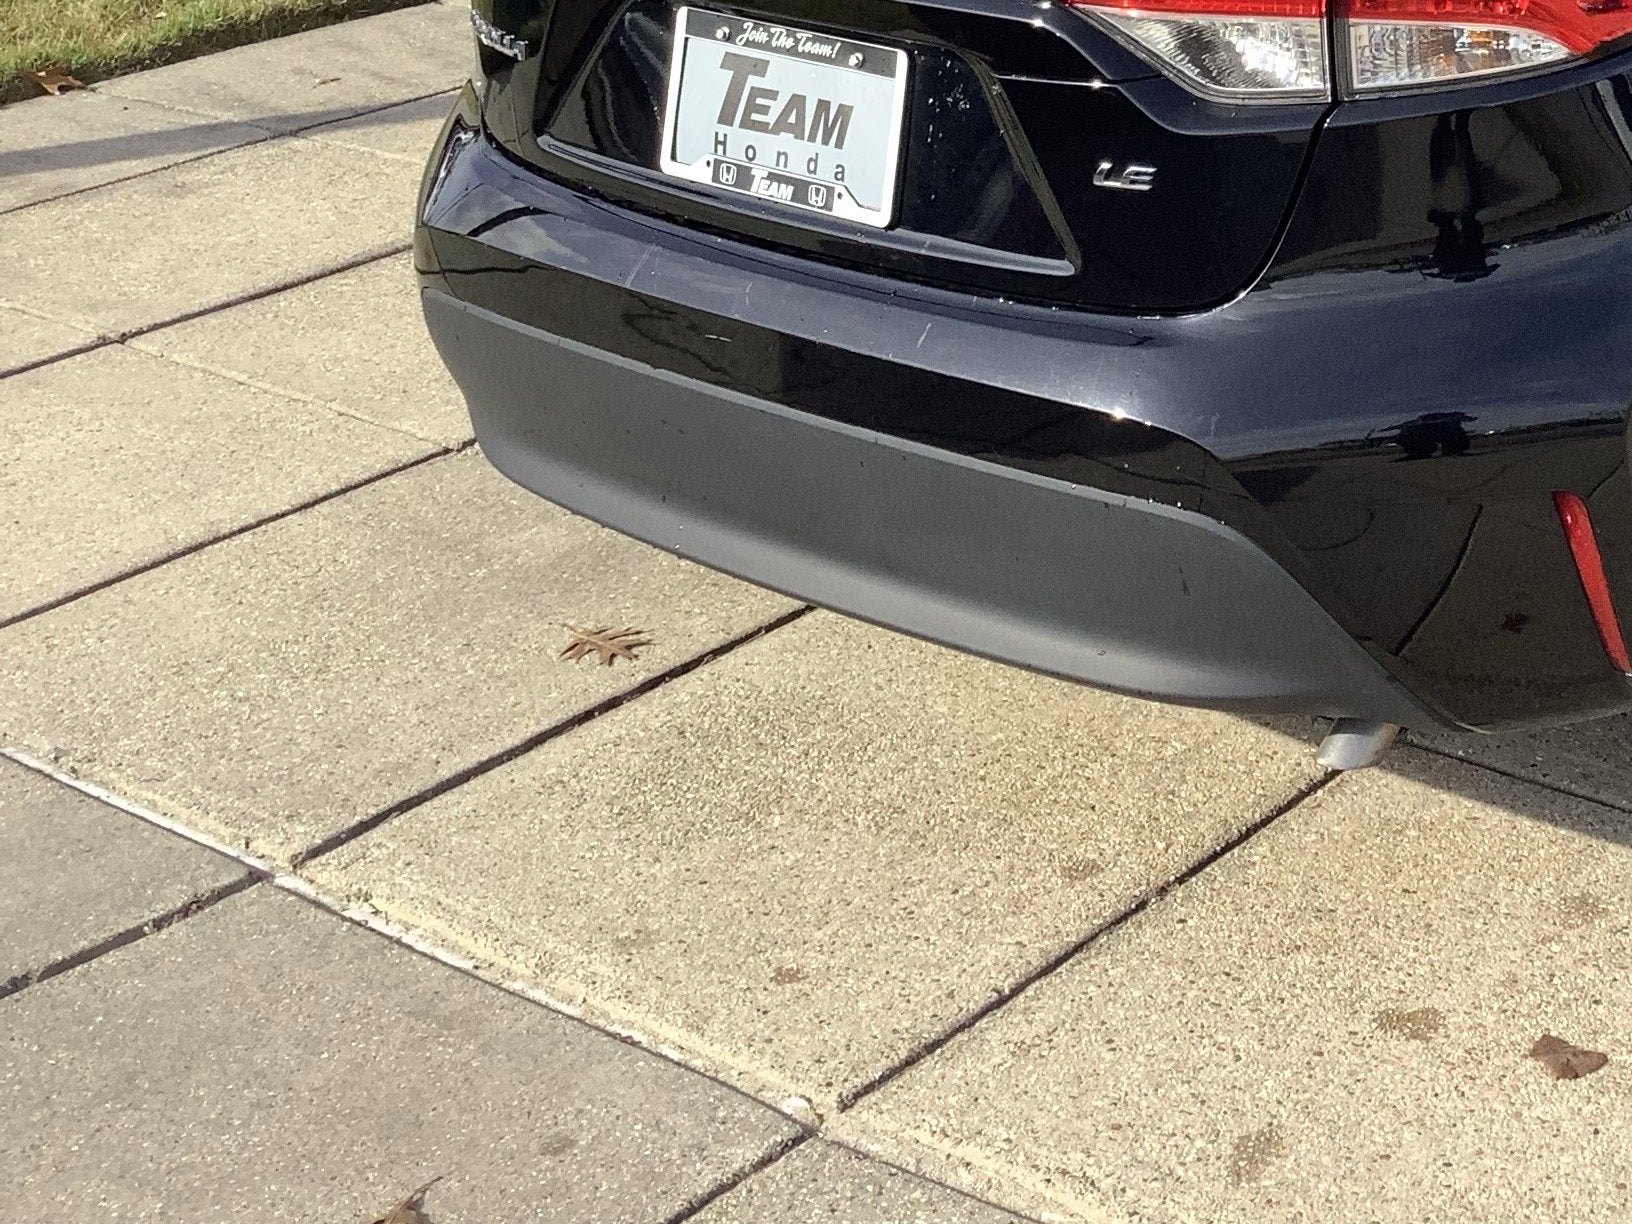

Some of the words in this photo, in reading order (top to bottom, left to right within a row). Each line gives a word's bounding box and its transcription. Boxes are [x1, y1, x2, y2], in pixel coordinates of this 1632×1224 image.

[736, 22, 769, 47] Join
[770, 26, 795, 50] The
[796, 32, 842, 59] Team!
[1092, 161, 1158, 192] LE
